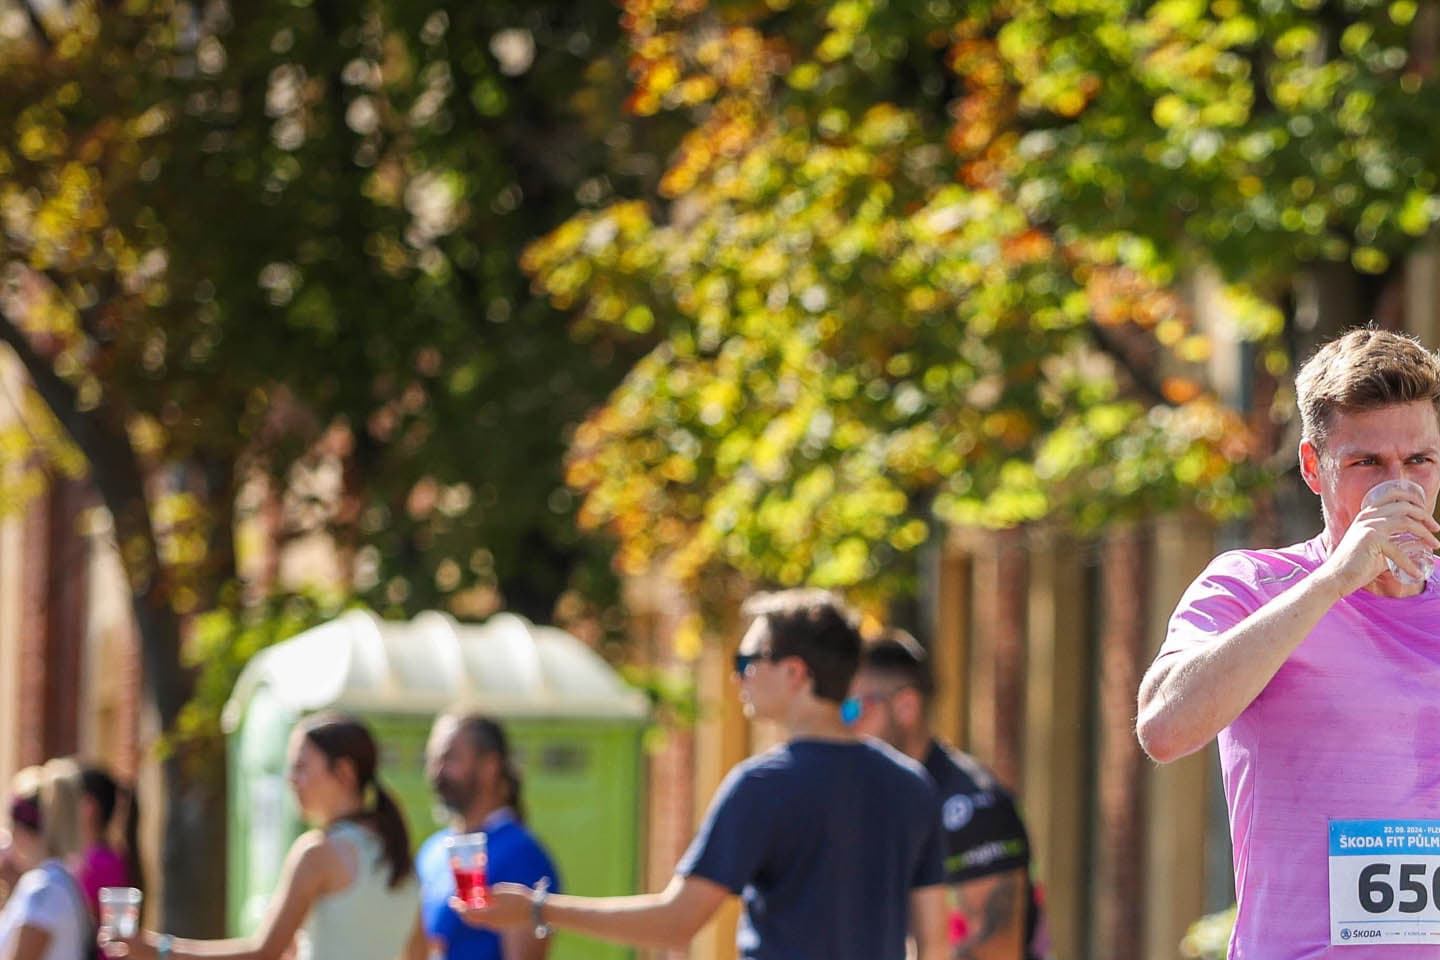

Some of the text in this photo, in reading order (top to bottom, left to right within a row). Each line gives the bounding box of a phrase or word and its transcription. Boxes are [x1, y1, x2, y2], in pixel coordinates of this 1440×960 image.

[1339, 834, 1383, 849] ŠKODA
[1386, 836, 1405, 848] FIT
[1352, 928, 1382, 938] ŠKODA
